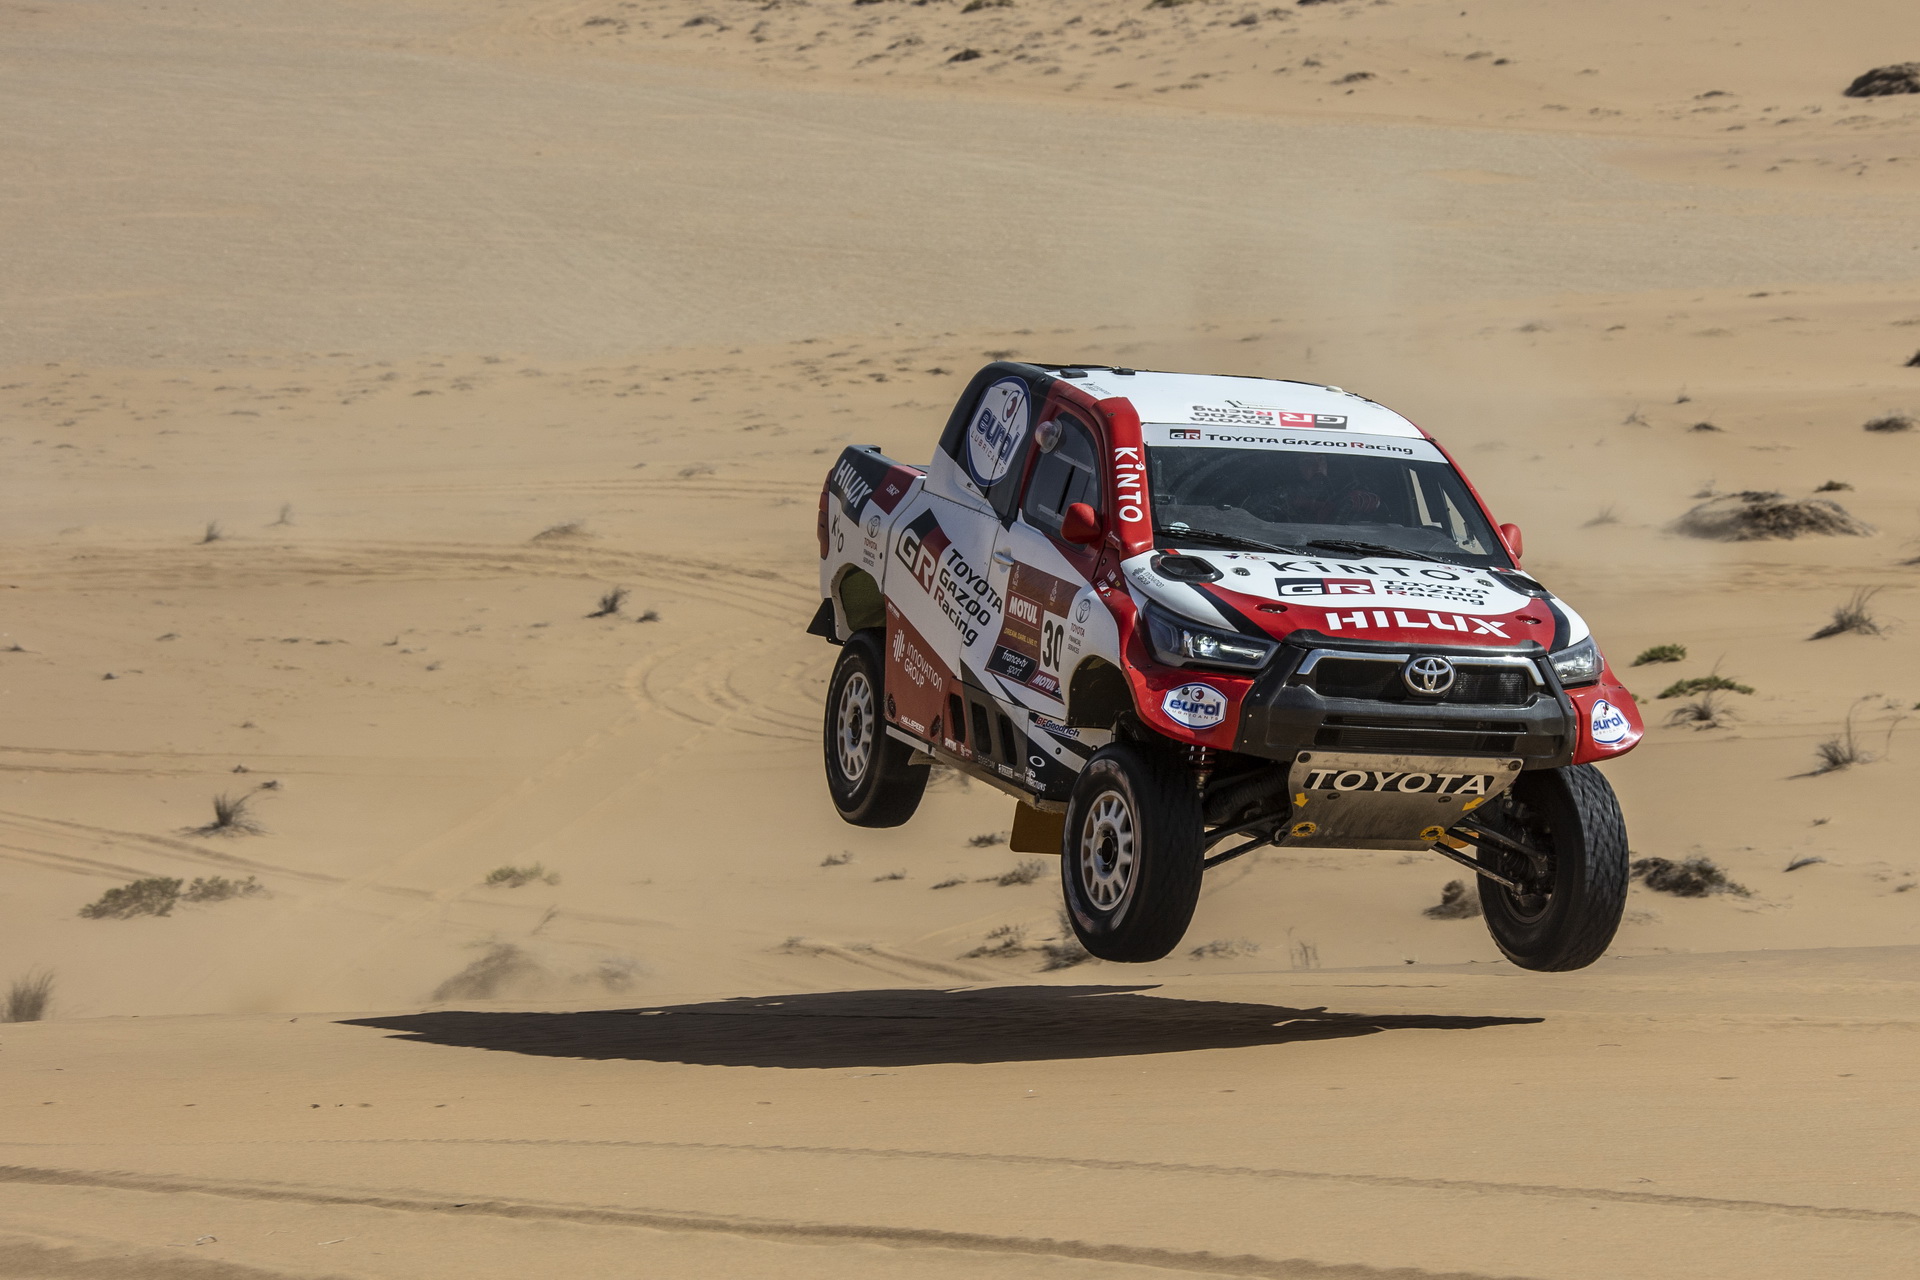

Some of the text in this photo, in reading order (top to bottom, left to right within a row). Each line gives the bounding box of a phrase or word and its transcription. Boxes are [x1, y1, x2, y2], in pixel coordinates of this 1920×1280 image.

[1192, 405, 1273, 416] Racing
[1194, 412, 1274, 421] GAZOO
[1280, 412, 1345, 425] GR
[1189, 416, 1276, 426] TOYOTA
[976, 407, 1021, 465] eurol
[1170, 430, 1413, 455] GR TOYOTA GAZOO Racing
[833, 458, 873, 509] HILUX
[863, 537, 877, 551] TOYOTA
[898, 527, 937, 592] GR
[946, 548, 1003, 614] TOYOTA
[1279, 582, 1373, 595] GR
[1379, 579, 1490, 595] TOYOTA
[939, 567, 991, 627] GAZOO
[1383, 585, 1484, 599] GAZOO
[1386, 590, 1485, 606] Racing
[933, 585, 979, 647] Racing
[1008, 596, 1038, 625] MOTUL
[1070, 622, 1086, 638] TOYOTA
[1325, 610, 1511, 639] HILUX
[904, 657, 925, 688] GROUP
[906, 641, 943, 693] INNOVATION
[1006, 664, 1023, 677] sport
[1032, 674, 1057, 692] MOTUL
[1169, 698, 1222, 717] eurol
[1034, 715, 1080, 738] BFGoodrich
[1592, 712, 1624, 731] eurol
[1310, 768, 1486, 795] TOYOTA
